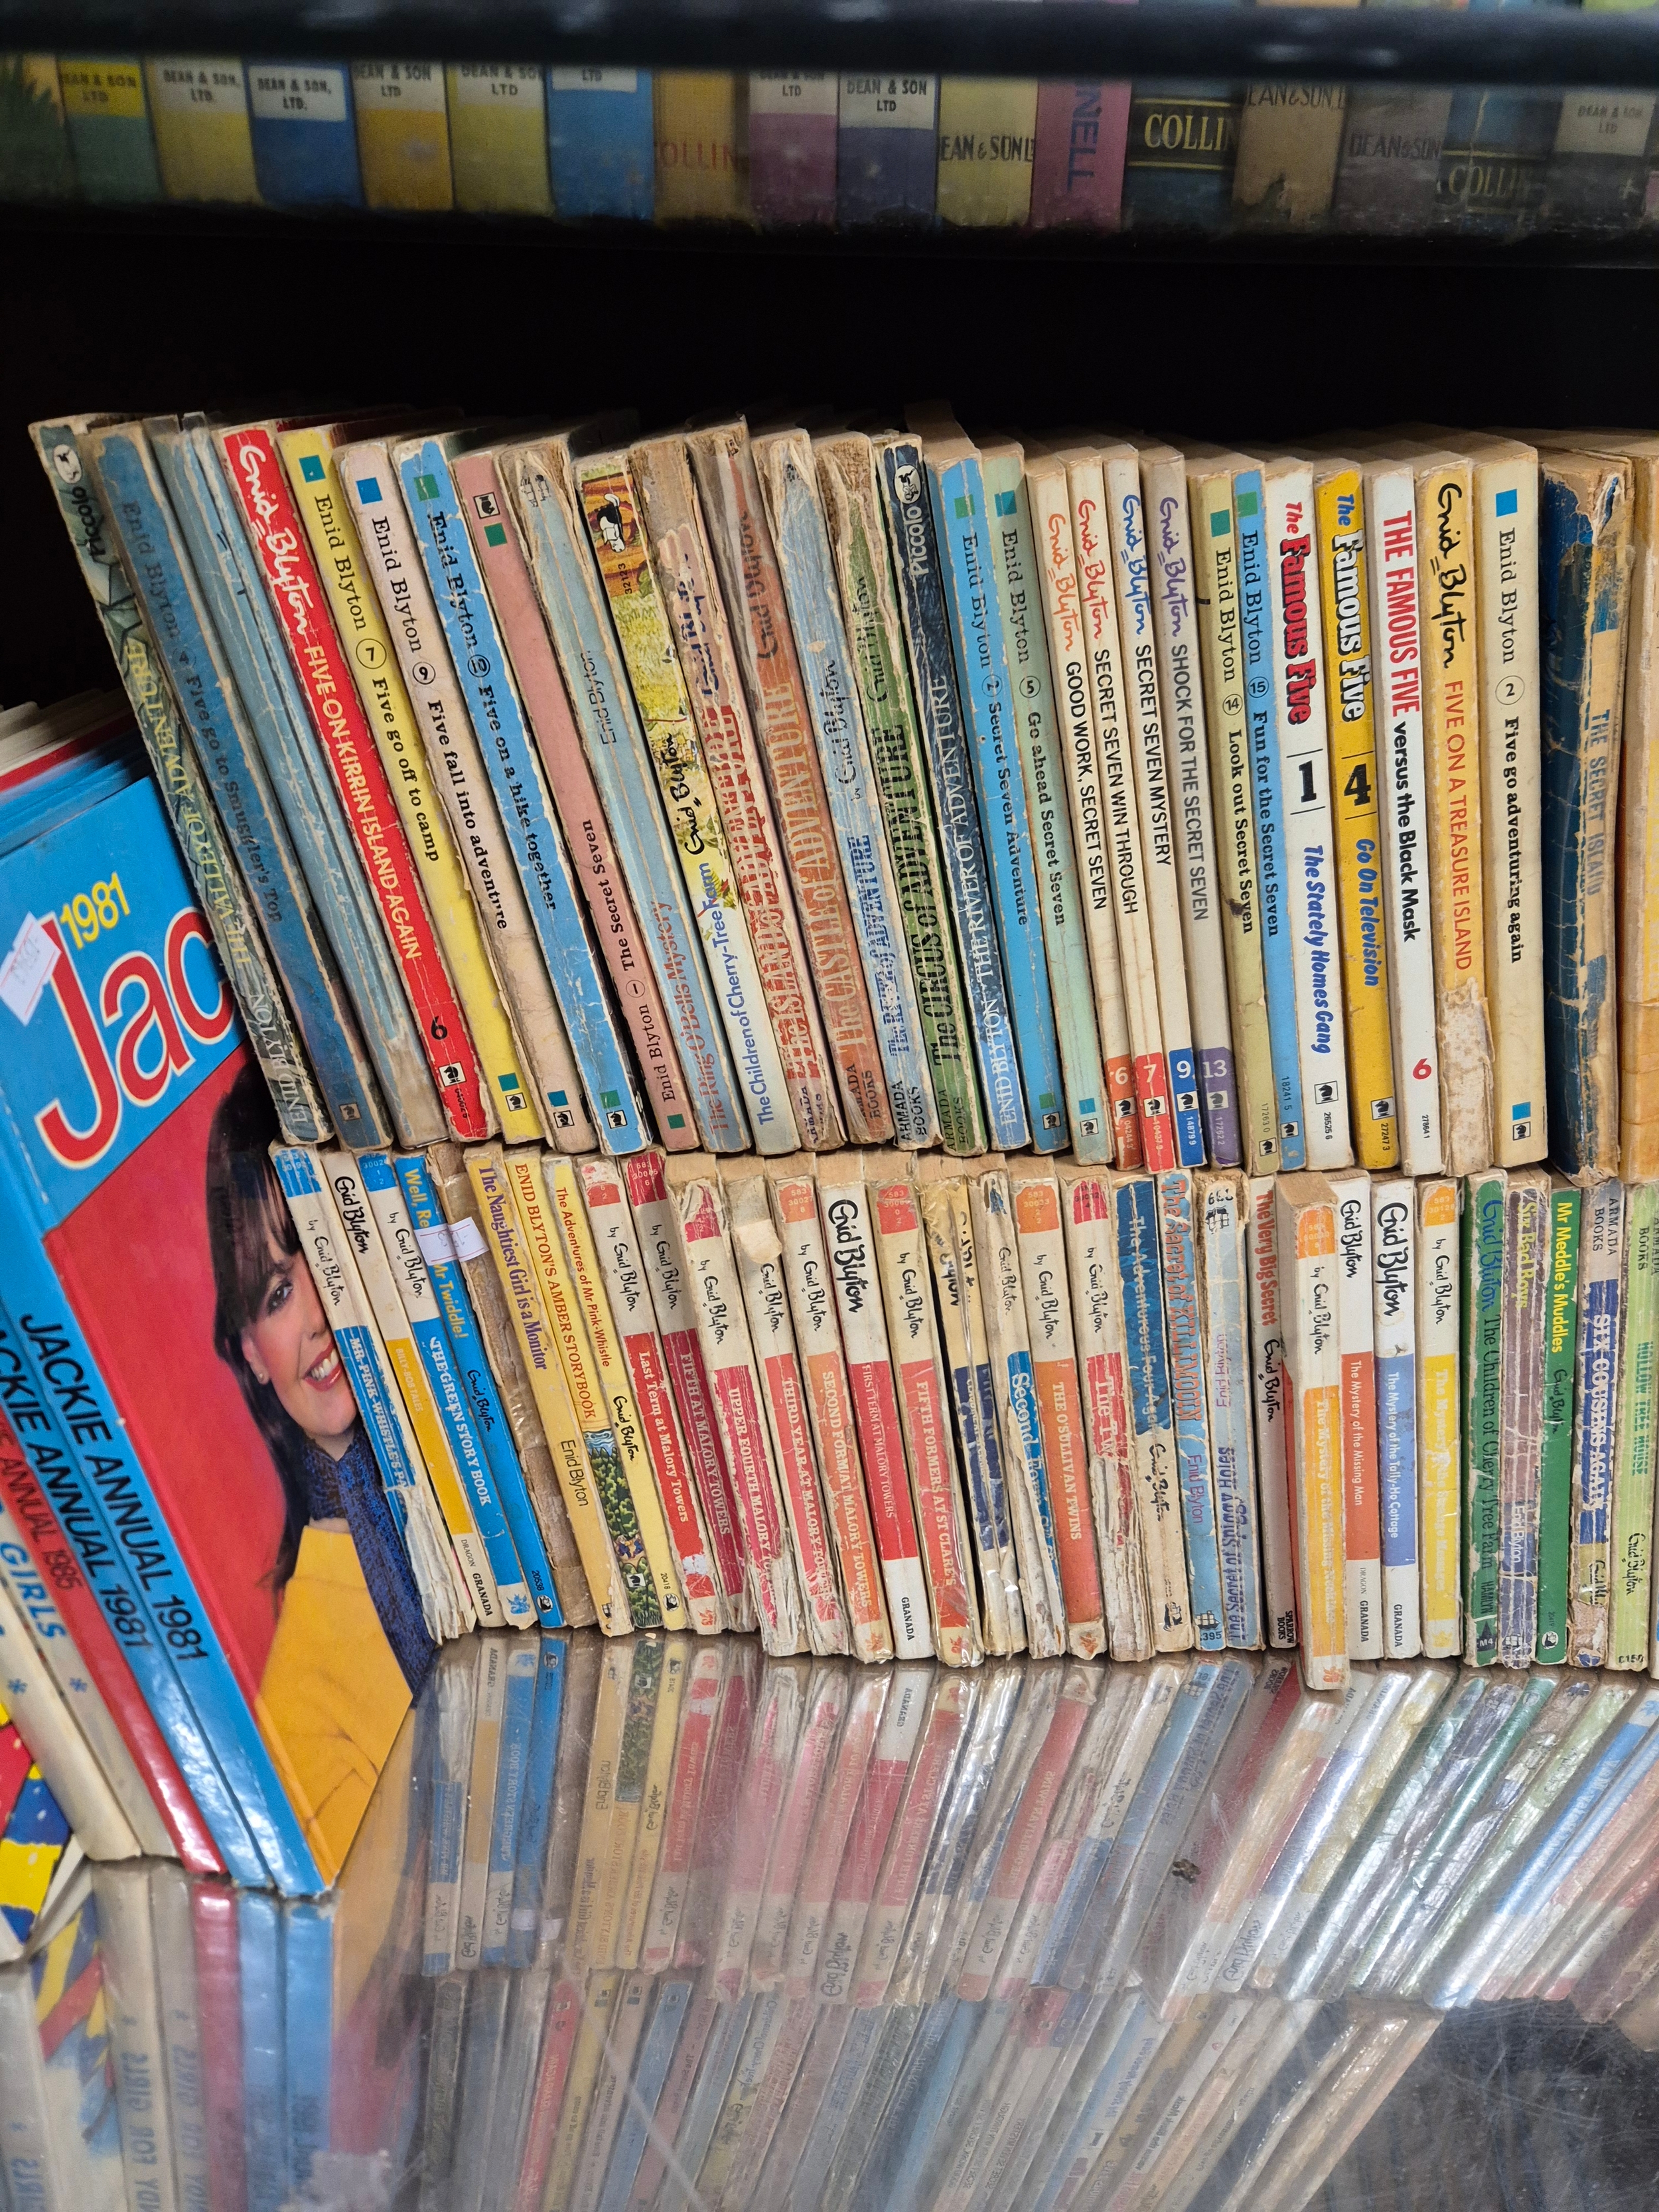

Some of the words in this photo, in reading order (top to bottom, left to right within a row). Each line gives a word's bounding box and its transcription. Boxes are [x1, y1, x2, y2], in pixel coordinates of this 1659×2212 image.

[492, 83, 518, 97] LTD
[782, 85, 801, 97] LTD
[846, 80, 881, 94] DEAN
[888, 80, 897, 94] &
[902, 80, 926, 95] SON
[877, 100, 897, 113] LTD
[240, 445, 279, 523] Enid
[1285, 502, 1303, 534] The
[1336, 494, 1354, 526] The
[1439, 482, 1462, 559] Enid
[903, 506, 930, 575] Piccolo
[1048, 513, 1066, 568] Enid
[1383, 511, 1413, 561] THE
[265, 528, 315, 635] Blyton
[617, 563, 632, 594] 32123
[1279, 534, 1312, 660] Famous
[1332, 530, 1363, 654] Famous
[1053, 573, 1080, 652] Blyton
[1386, 567, 1416, 663] FAMOUS
[1431, 563, 1467, 670] Blyton
[303, 646, 336, 694] FIVE
[1066, 662, 1085, 718] GOOD
[1285, 660, 1317, 725] Five
[1340, 656, 1370, 723] Five
[1391, 668, 1420, 716] FIVE
[321, 698, 348, 737] ON
[1444, 680, 1463, 729] FIVE
[1072, 721, 1094, 782] WORK,
[1392, 722, 1413, 789] versus
[1445, 733, 1465, 769] ON
[334, 741, 374, 815] KIRRIN
[1299, 763, 1317, 803] 1
[1344, 764, 1371, 806] 4
[1449, 779, 1466, 792] A
[1080, 785, 1103, 853] SECRET
[1396, 792, 1415, 827] the
[362, 816, 399, 893] ISLAND
[583, 819, 606, 875] Seven
[1304, 845, 1324, 878] The
[1356, 838, 1376, 863] Go
[1400, 830, 1418, 887] Black
[1449, 795, 1469, 898] TREASURE
[699, 862, 720, 908] Farm
[1088, 855, 1106, 909] SEVEN
[1358, 868, 1377, 894] On
[60, 871, 130, 949] 1981
[386, 894, 421, 960] AGAIN
[598, 880, 624, 934] Secret
[1304, 881, 1328, 947] Stately
[1402, 890, 1420, 942] Mask
[618, 937, 635, 971] The
[711, 910, 745, 1007] Cherry-Tree
[1359, 896, 1382, 986] Television
[1453, 901, 1472, 970] ISLAND
[1311, 951, 1331, 1008] Homes
[431, 1017, 447, 1040] 6
[642, 1003, 664, 1059] Blyton
[731, 1009, 751, 1026] of
[1311, 1011, 1333, 1054] Gang
[653, 1063, 676, 1102] Enid
[739, 1028, 767, 1096] Children
[1115, 1067, 1128, 1084] 6
[1412, 1059, 1432, 1080] 6
[757, 1096, 774, 1126] The
[478, 1167, 498, 1193] The
[335, 1176, 356, 1208] Enid
[348, 1207, 370, 1254] Blyton
[828, 1199, 861, 1244] Enid
[1256, 1191, 1274, 1219] The
[1340, 1199, 1362, 1231] Enid
[1378, 1203, 1409, 1246] Enid
[1556, 1202, 1573, 1224] Mr
[1607, 1198, 1617, 1256] ARMADA
[486, 1193, 520, 1268] Naughtiest
[1254, 1222, 1275, 1255] Very
[1593, 1208, 1605, 1252] BOOKS
[555, 1187, 567, 1207] The
[561, 1211, 584, 1273] Adventures
[590, 1305, 611, 1367] Pink-Whistle
[1256, 1257, 1277, 1280] Big
[1340, 1231, 1363, 1278] Blyton
[1554, 1227, 1571, 1291] Meddle's
[508, 1269, 532, 1296] Girl
[515, 1163, 535, 1203] ENID
[547, 1281, 571, 1333] AMBER
[563, 1335, 596, 1419] STORYBOOK
[834, 1244, 867, 1313] Blyton
[1375, 1246, 1409, 1315] Blyton
[517, 1297, 534, 1309] is
[1260, 1282, 1279, 1326] Secret
[1551, 1294, 1569, 1353] Muddles
[523, 1321, 548, 1371] Monitor
[1263, 1339, 1281, 1374] Enid
[863, 1364, 875, 1392] FIRST
[1351, 1361, 1362, 1378] The
[1388, 1372, 1400, 1390] The
[430, 1337, 449, 1371] THE
[457, 1424, 480, 1467] STORY
[471, 1469, 492, 1507] BOOK
[613, 1396, 631, 1425] Enid
[867, 1394, 881, 1422] TERM
[1265, 1376, 1280, 1423] Blyton
[1350, 1379, 1362, 1419] Mystery
[1386, 1392, 1400, 1432] Mystery
[620, 1424, 640, 1461] Blyton
[639, 1351, 654, 1380] Last
[647, 1381, 662, 1416] Term
[659, 1432, 678, 1477] Malory
[671, 1479, 689, 1523] Towers
[874, 1438, 891, 1480] MALORY
[561, 1439, 577, 1469] Enid
[569, 1471, 589, 1507] Blyton
[1053, 1382, 1064, 1411] THE
[1065, 1496, 1082, 1540] TWINS
[1352, 1450, 1364, 1487] Missing
[1387, 1460, 1400, 1500] Tally-Ho
[19, 1313, 113, 1445] JACKIE
[85, 1455, 173, 1591] ANNUAL
[153, 1593, 209, 1662] 1981
[881, 1479, 895, 1518] TOWERS
[1388, 1502, 1400, 1538] Cottage
[27, 1444, 117, 1578] ANNUAL
[97, 1583, 153, 1650] 1981
[461, 1539, 476, 1568] DRAGON
[0, 1541, 67, 1639] GIRLS
[472, 1573, 493, 1617] GRANADA
[901, 1596, 914, 1641] GRANADA
[1277, 1617, 1285, 1640] BOOKS
[1360, 1600, 1368, 1643] GRANADA
[1394, 1604, 1403, 1648] GRANADA
